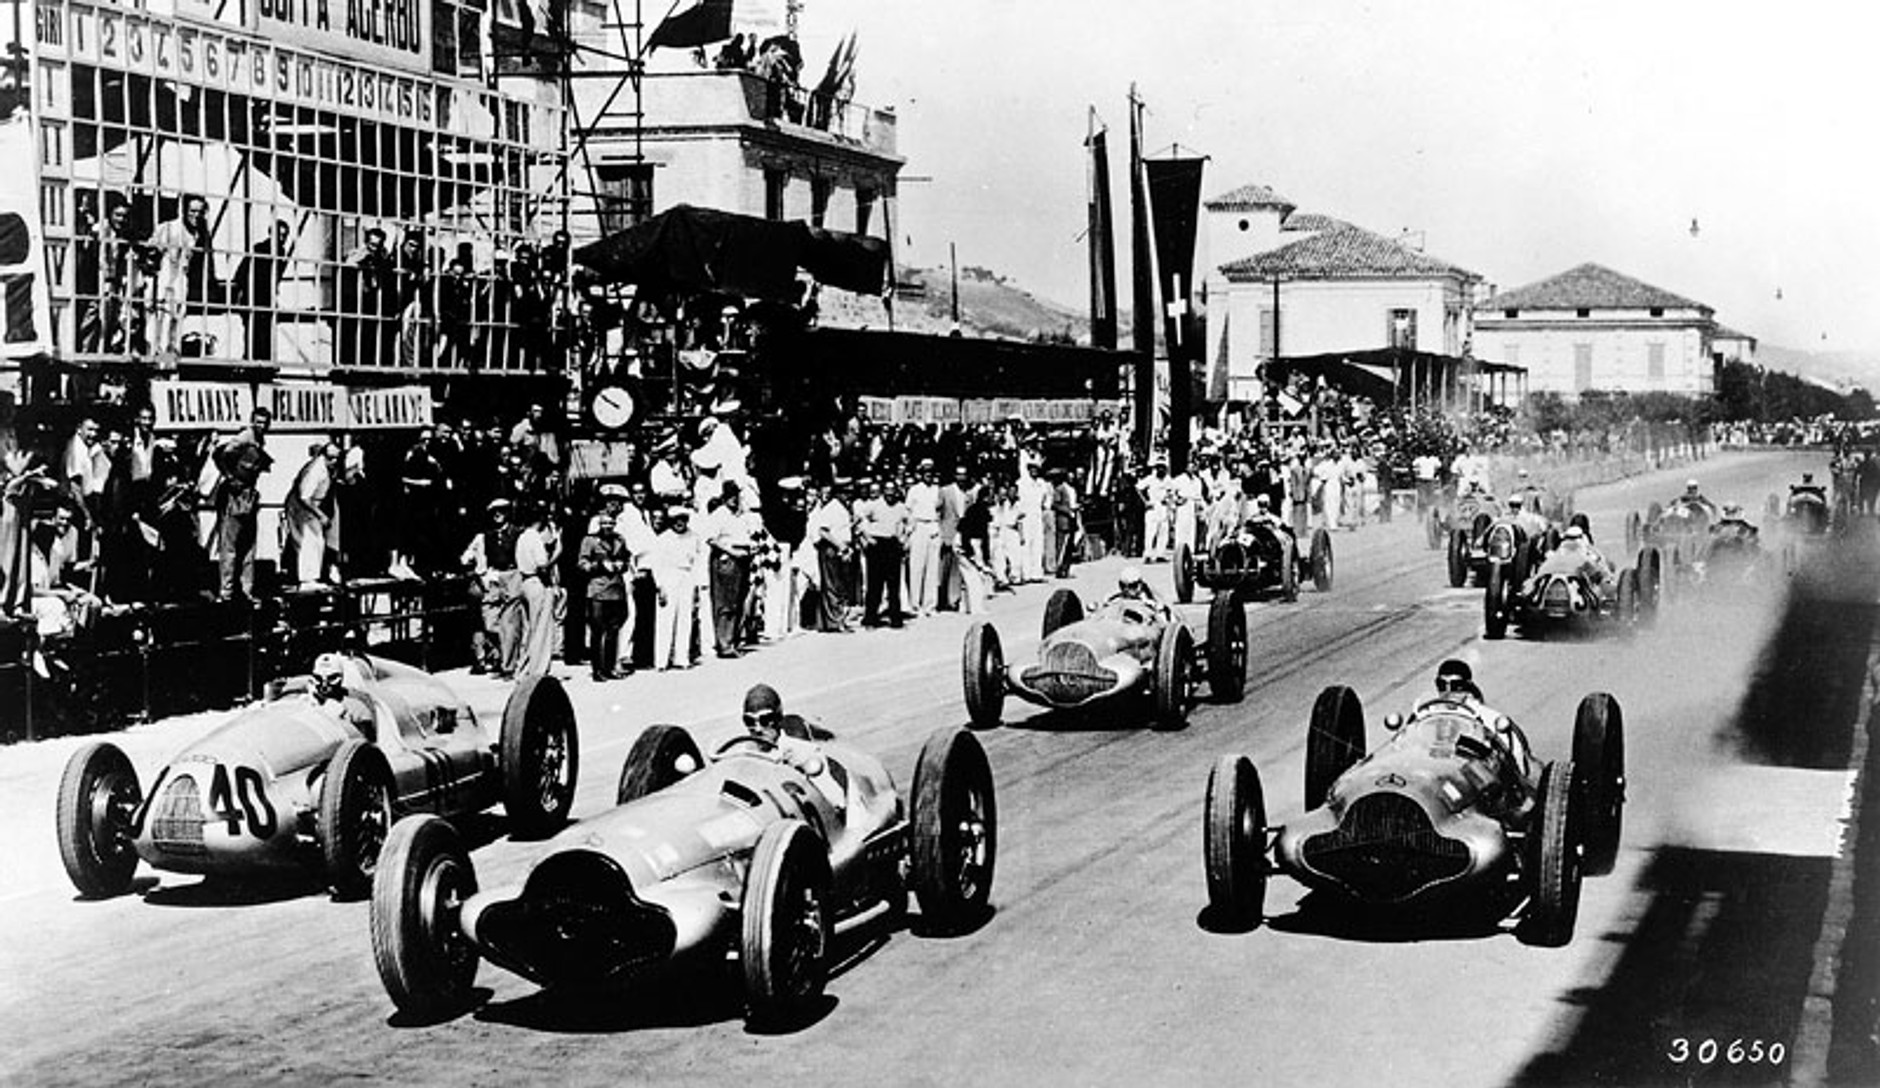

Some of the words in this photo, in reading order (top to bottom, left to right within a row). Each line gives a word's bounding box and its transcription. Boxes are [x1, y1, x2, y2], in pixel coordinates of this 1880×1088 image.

[36, 6, 62, 45] GIRI
[77, 15, 84, 51] 1
[103, 18, 117, 57] 2
[129, 24, 144, 62] 3
[181, 36, 194, 73] 5
[206, 42, 219, 77] 6
[227, 41, 246, 82] 7
[254, 51, 266, 86] 8
[277, 56, 289, 92] 9
[296, 62, 312, 98] 10
[337, 69, 354, 105] 12
[357, 73, 375, 109] 13
[397, 85, 413, 117] 15
[209, 763, 278, 840] 40
